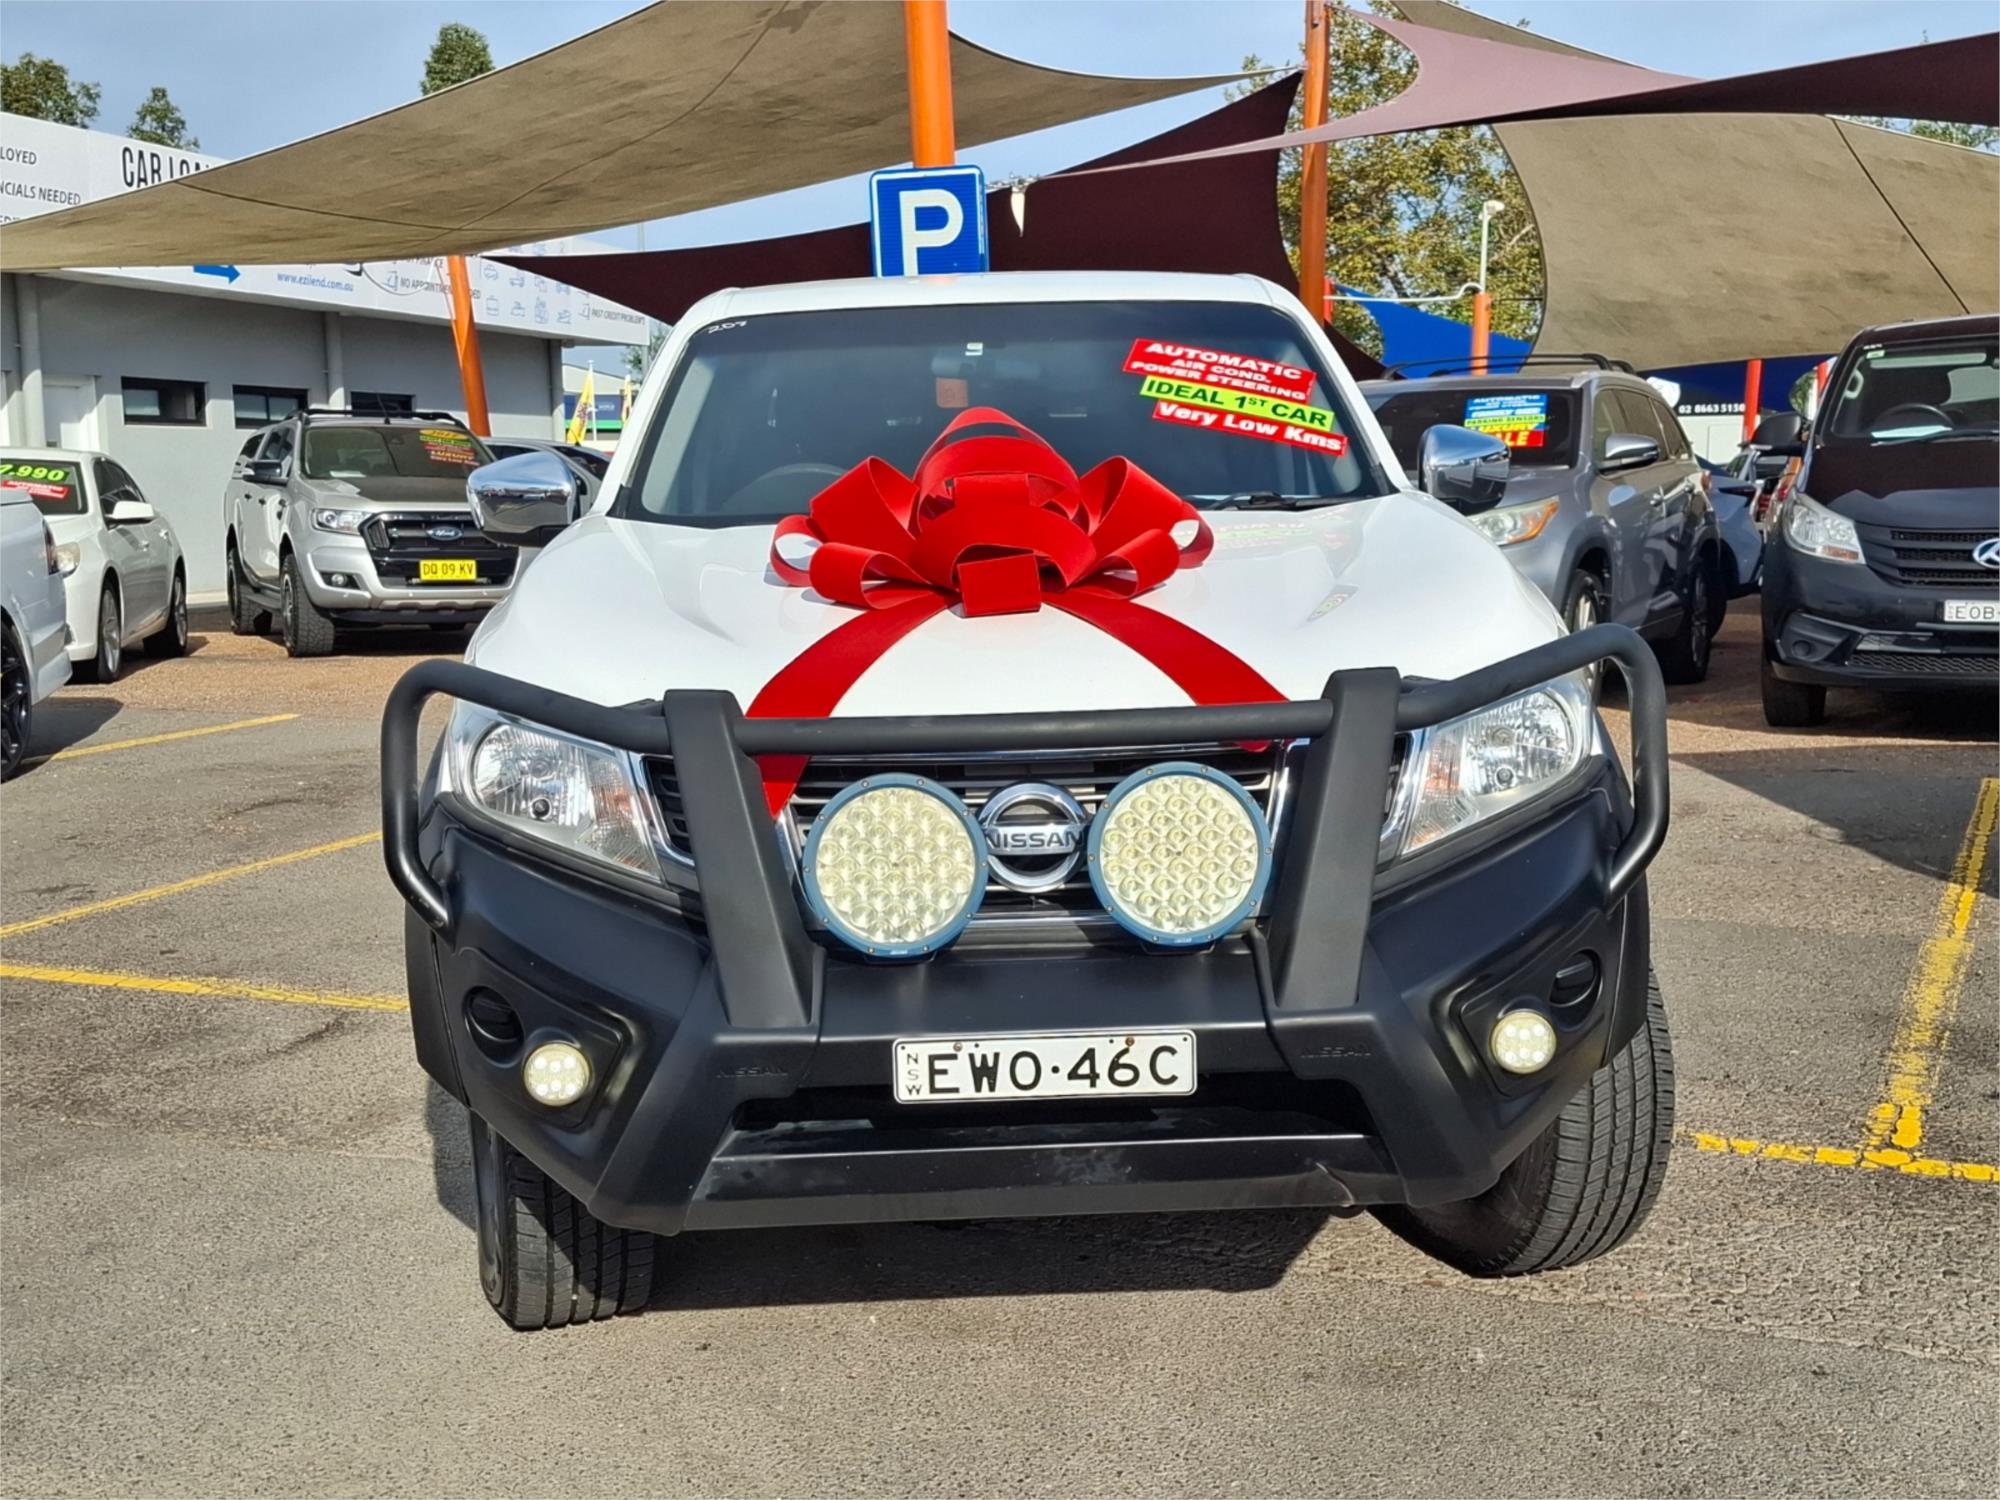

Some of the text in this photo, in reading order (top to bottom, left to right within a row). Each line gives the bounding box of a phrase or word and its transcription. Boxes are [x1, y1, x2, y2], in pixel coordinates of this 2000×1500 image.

[122, 146, 209, 188] CAR LO
[38, 186, 81, 205] NEEDED
[899, 188, 964, 277] P
[1145, 343, 1302, 380] AUTOMATIC
[1171, 359, 1271, 384] AIR COND.
[1131, 361, 1307, 400] POWER STEERING
[1146, 380, 1225, 405] IDEAL
[1271, 403, 1327, 427] CAR
[1678, 404, 1692, 414] 02
[1159, 402, 1342, 451] Very Low Kms
[442, 563, 455, 575] 09
[460, 563, 473, 575] KV
[986, 831, 1082, 848] NISSAN
